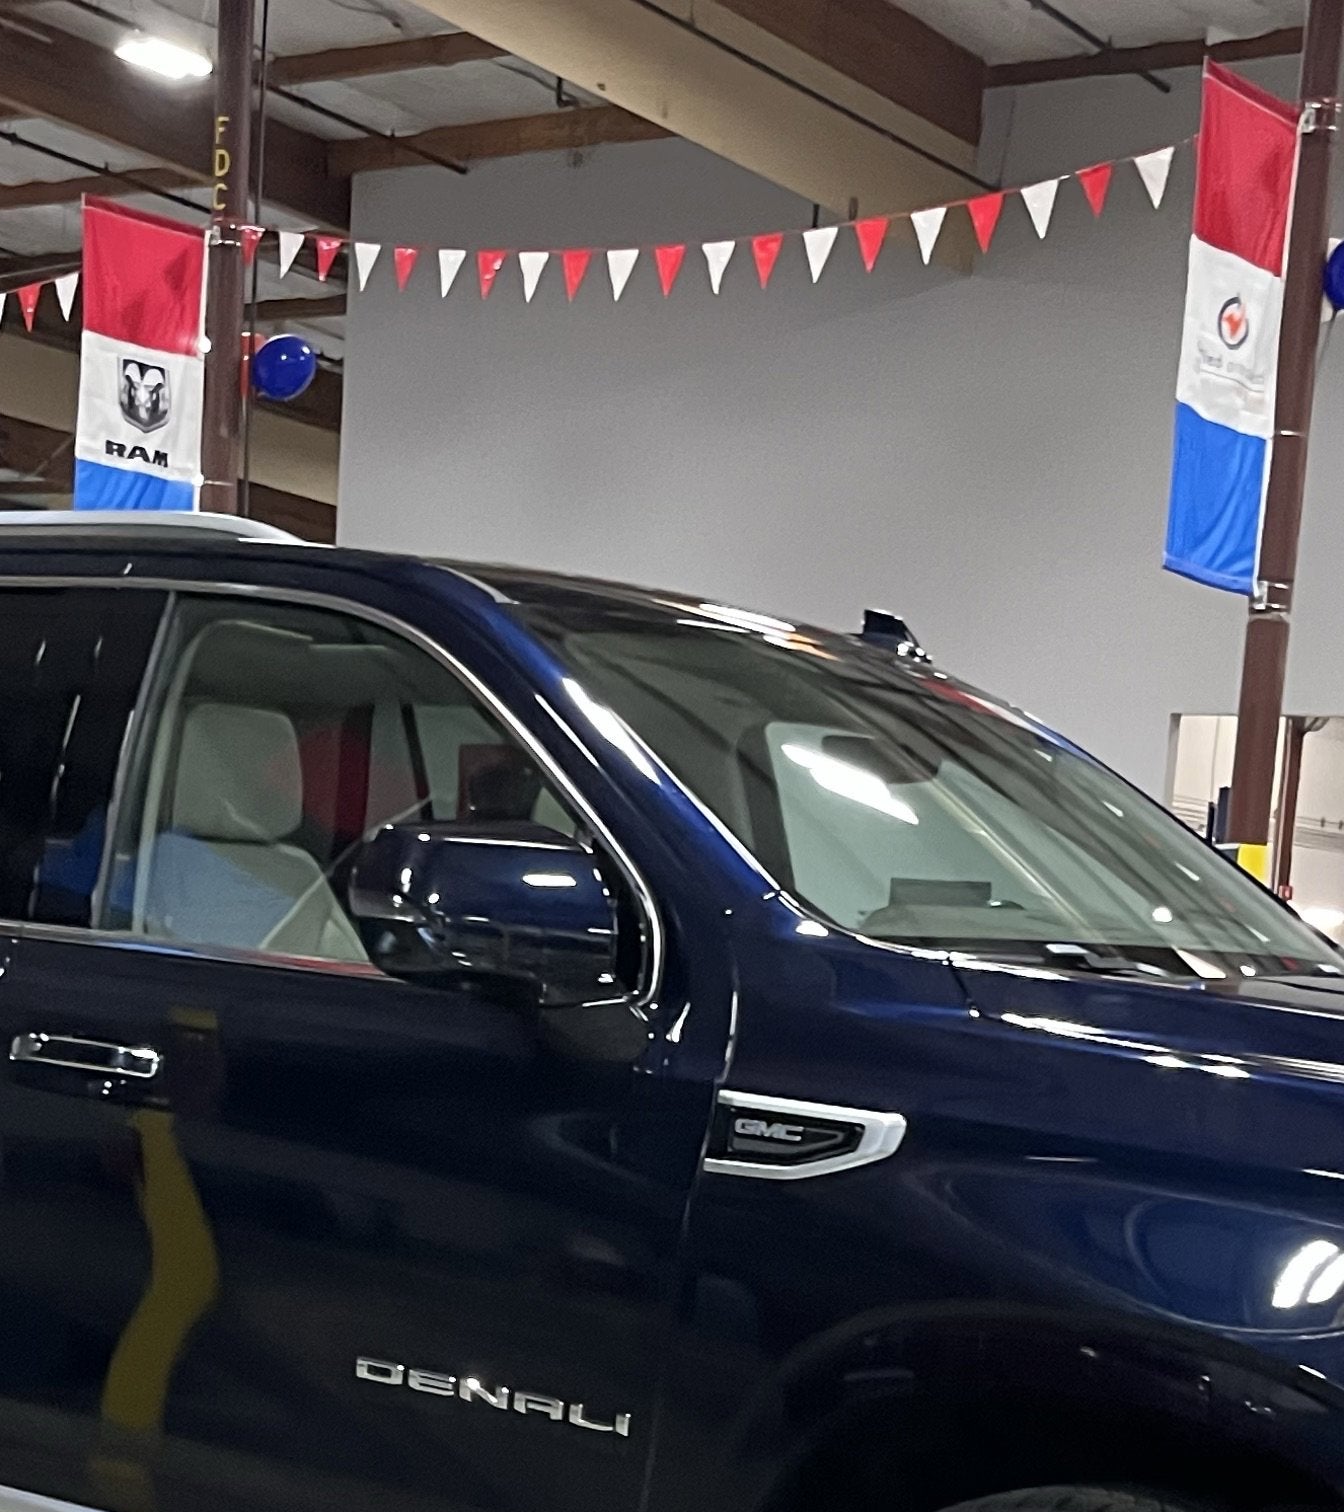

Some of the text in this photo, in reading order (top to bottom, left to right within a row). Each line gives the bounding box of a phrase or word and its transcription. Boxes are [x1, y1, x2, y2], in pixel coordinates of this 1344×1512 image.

[105, 440, 168, 468] RAM
[735, 1118, 804, 1141] GMC
[356, 1356, 629, 1436] DENALI
